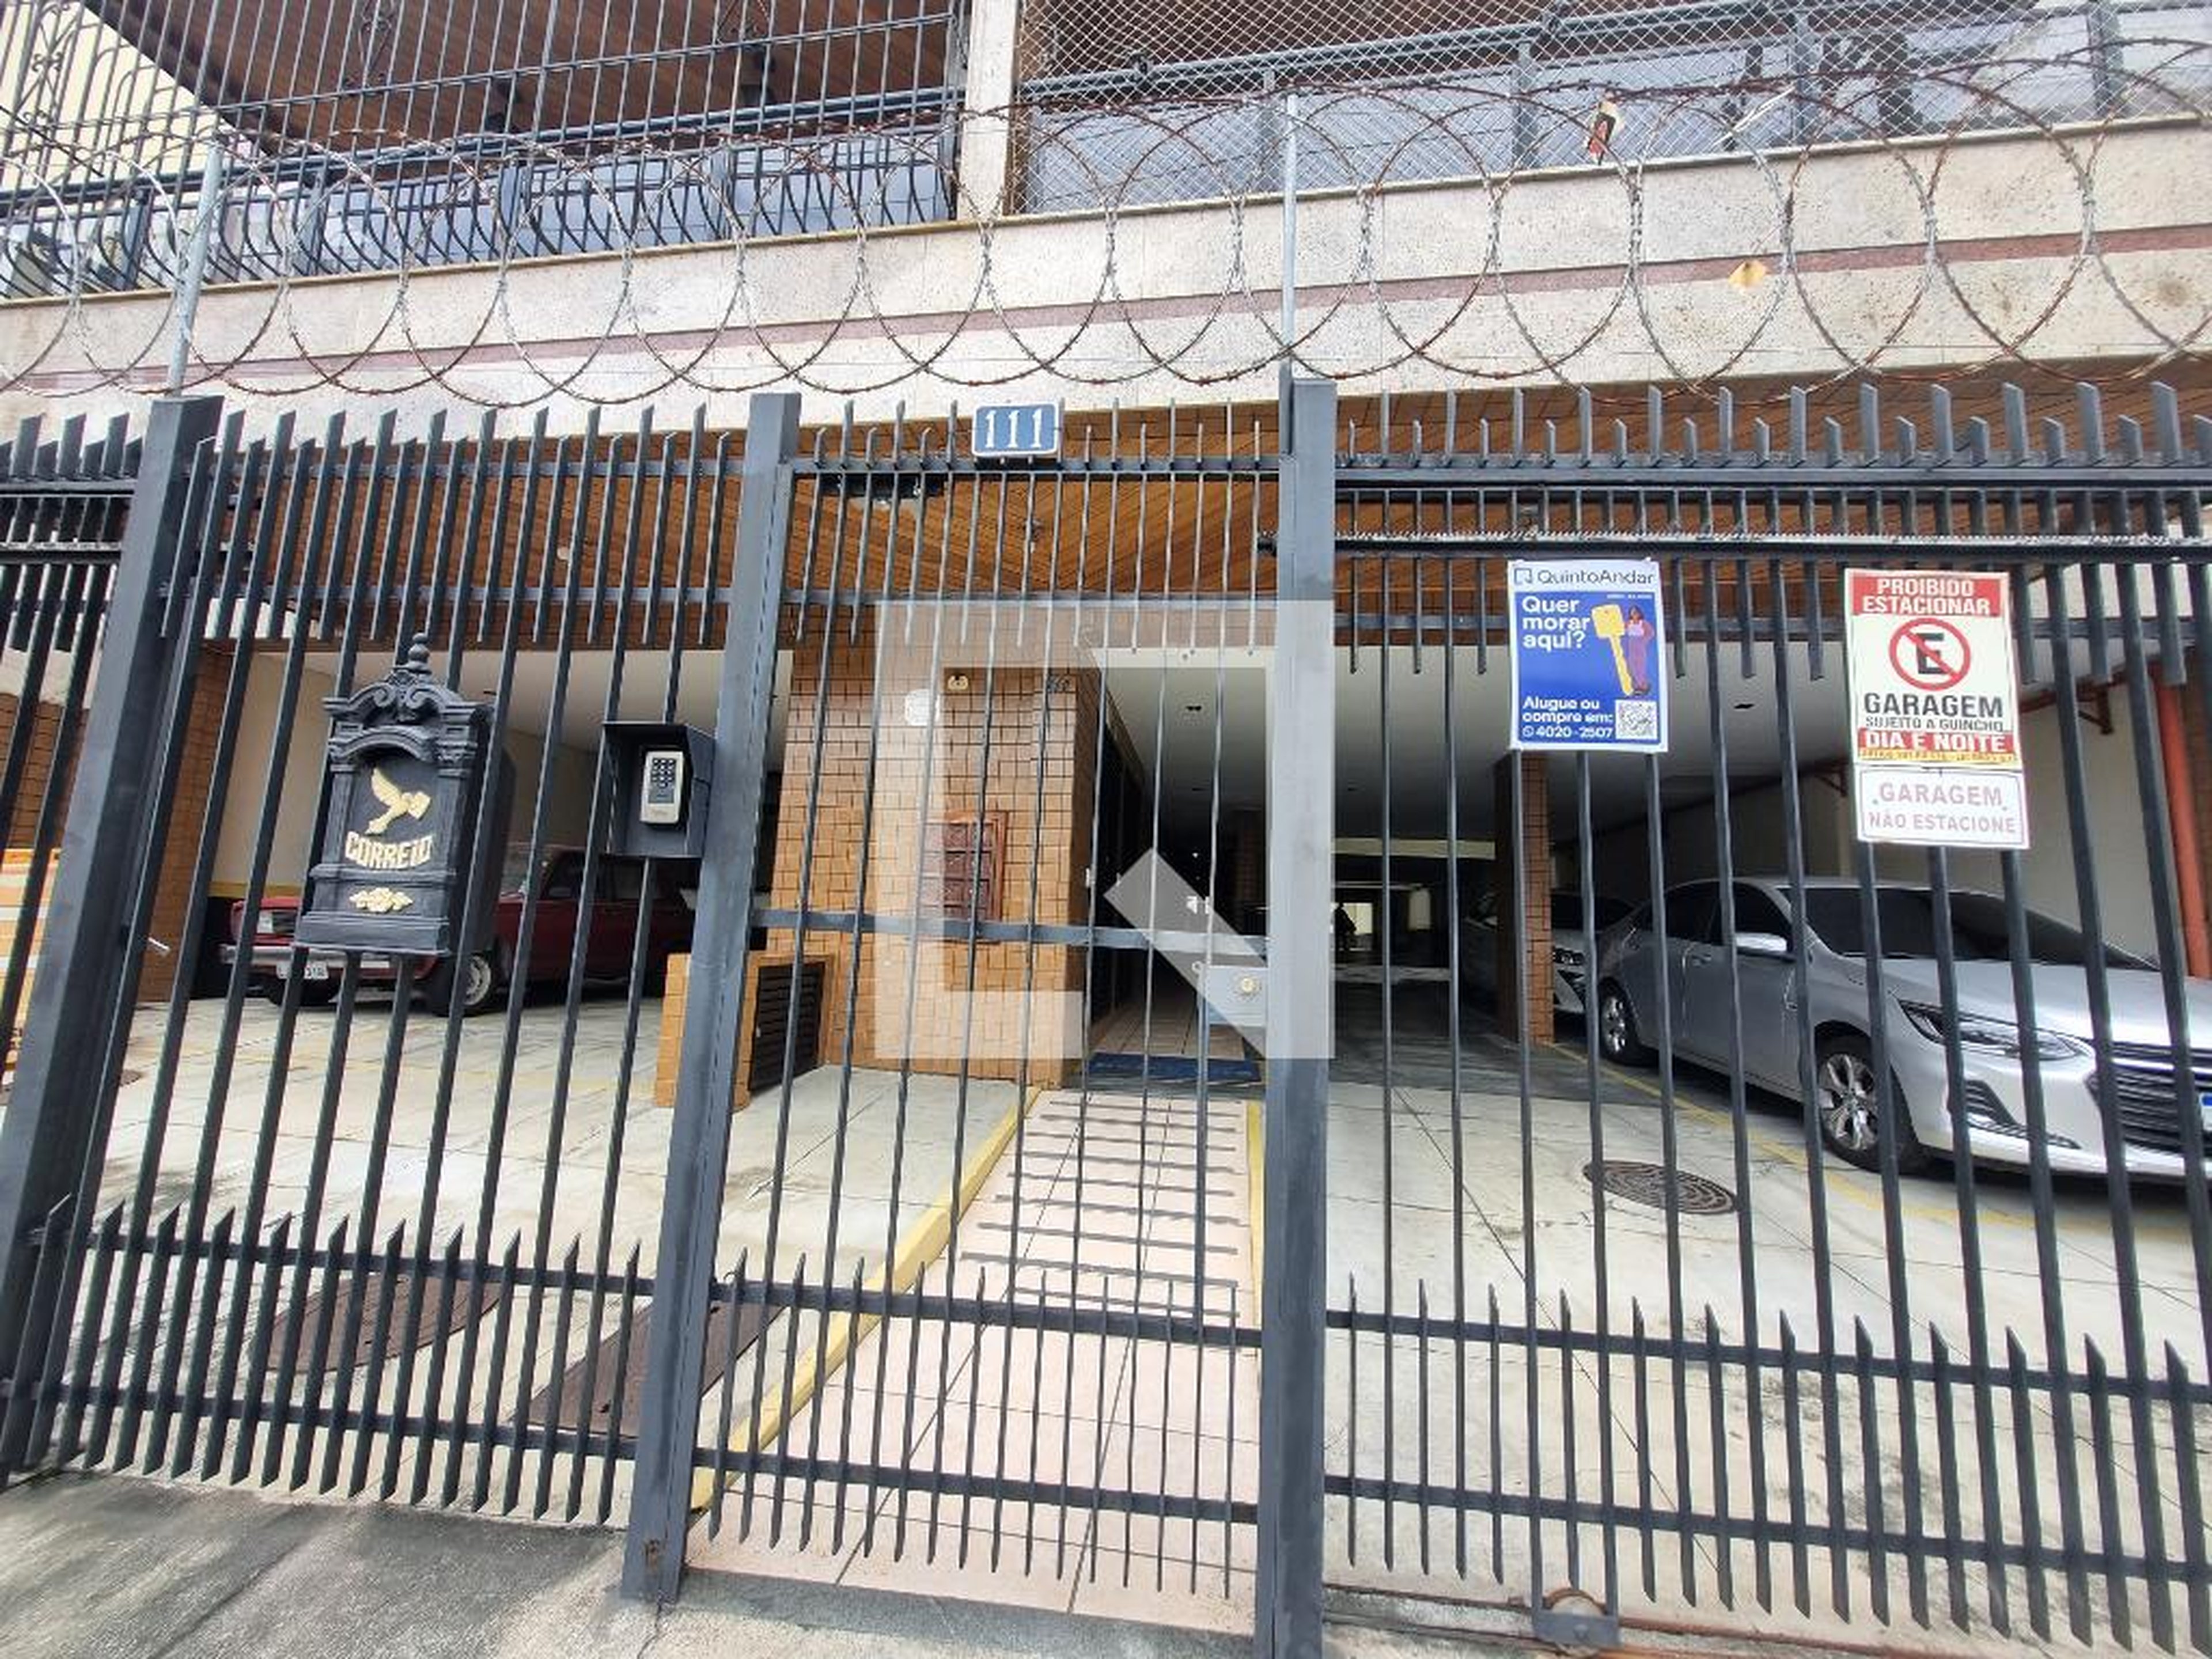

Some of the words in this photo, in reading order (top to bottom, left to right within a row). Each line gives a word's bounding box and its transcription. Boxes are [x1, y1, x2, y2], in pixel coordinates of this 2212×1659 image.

[984, 408, 1043, 449] 111
[1537, 569, 1654, 584] QuintoAndar
[1876, 578, 1974, 597] PROIBIDO
[1522, 596, 1580, 613] Quer
[1862, 596, 1990, 615] ESTACIONAR
[1522, 617, 1590, 630] morar
[1522, 631, 1586, 651] aqui?
[1522, 696, 1577, 711] Alugue
[1581, 699, 1600, 709] ou
[1863, 693, 2003, 718] GARAGEM
[1522, 712, 1582, 724] compre
[1865, 717, 1922, 729] SUJEITO
[1925, 719, 1936, 729] A
[1939, 719, 2003, 733] GUINCHO
[1866, 730, 1904, 748] DIA
[1911, 733, 1926, 749] E
[1934, 733, 2006, 752] NOITE
[1880, 783, 2002, 806] GARAGEM
[1913, 814, 2016, 833] ESTACIONE
[346, 831, 433, 868] CORREIO
